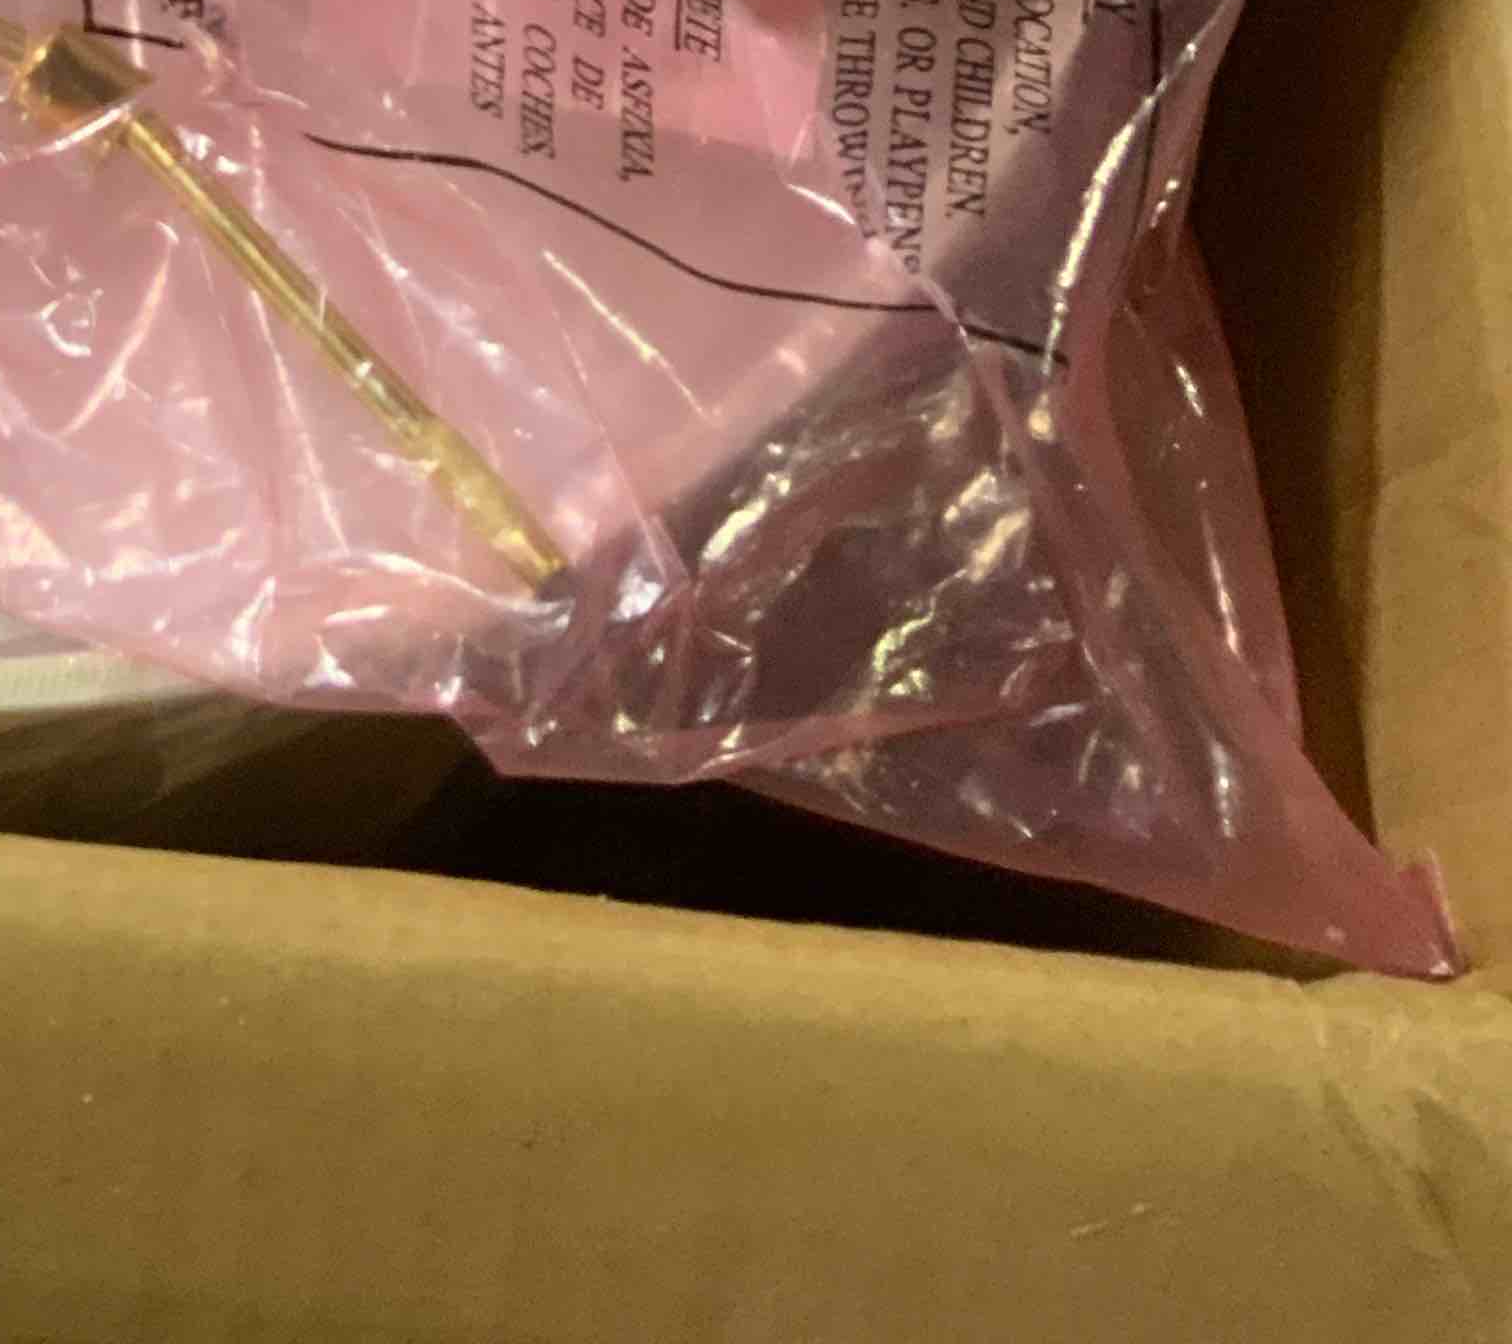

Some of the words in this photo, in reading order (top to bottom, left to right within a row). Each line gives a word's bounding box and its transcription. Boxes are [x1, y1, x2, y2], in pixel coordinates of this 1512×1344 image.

[467, 2, 508, 120] ANTES
[569, 55, 605, 110] DE
[893, 24, 938, 74] OR
[617, 46, 657, 184] ASFIXIA,
